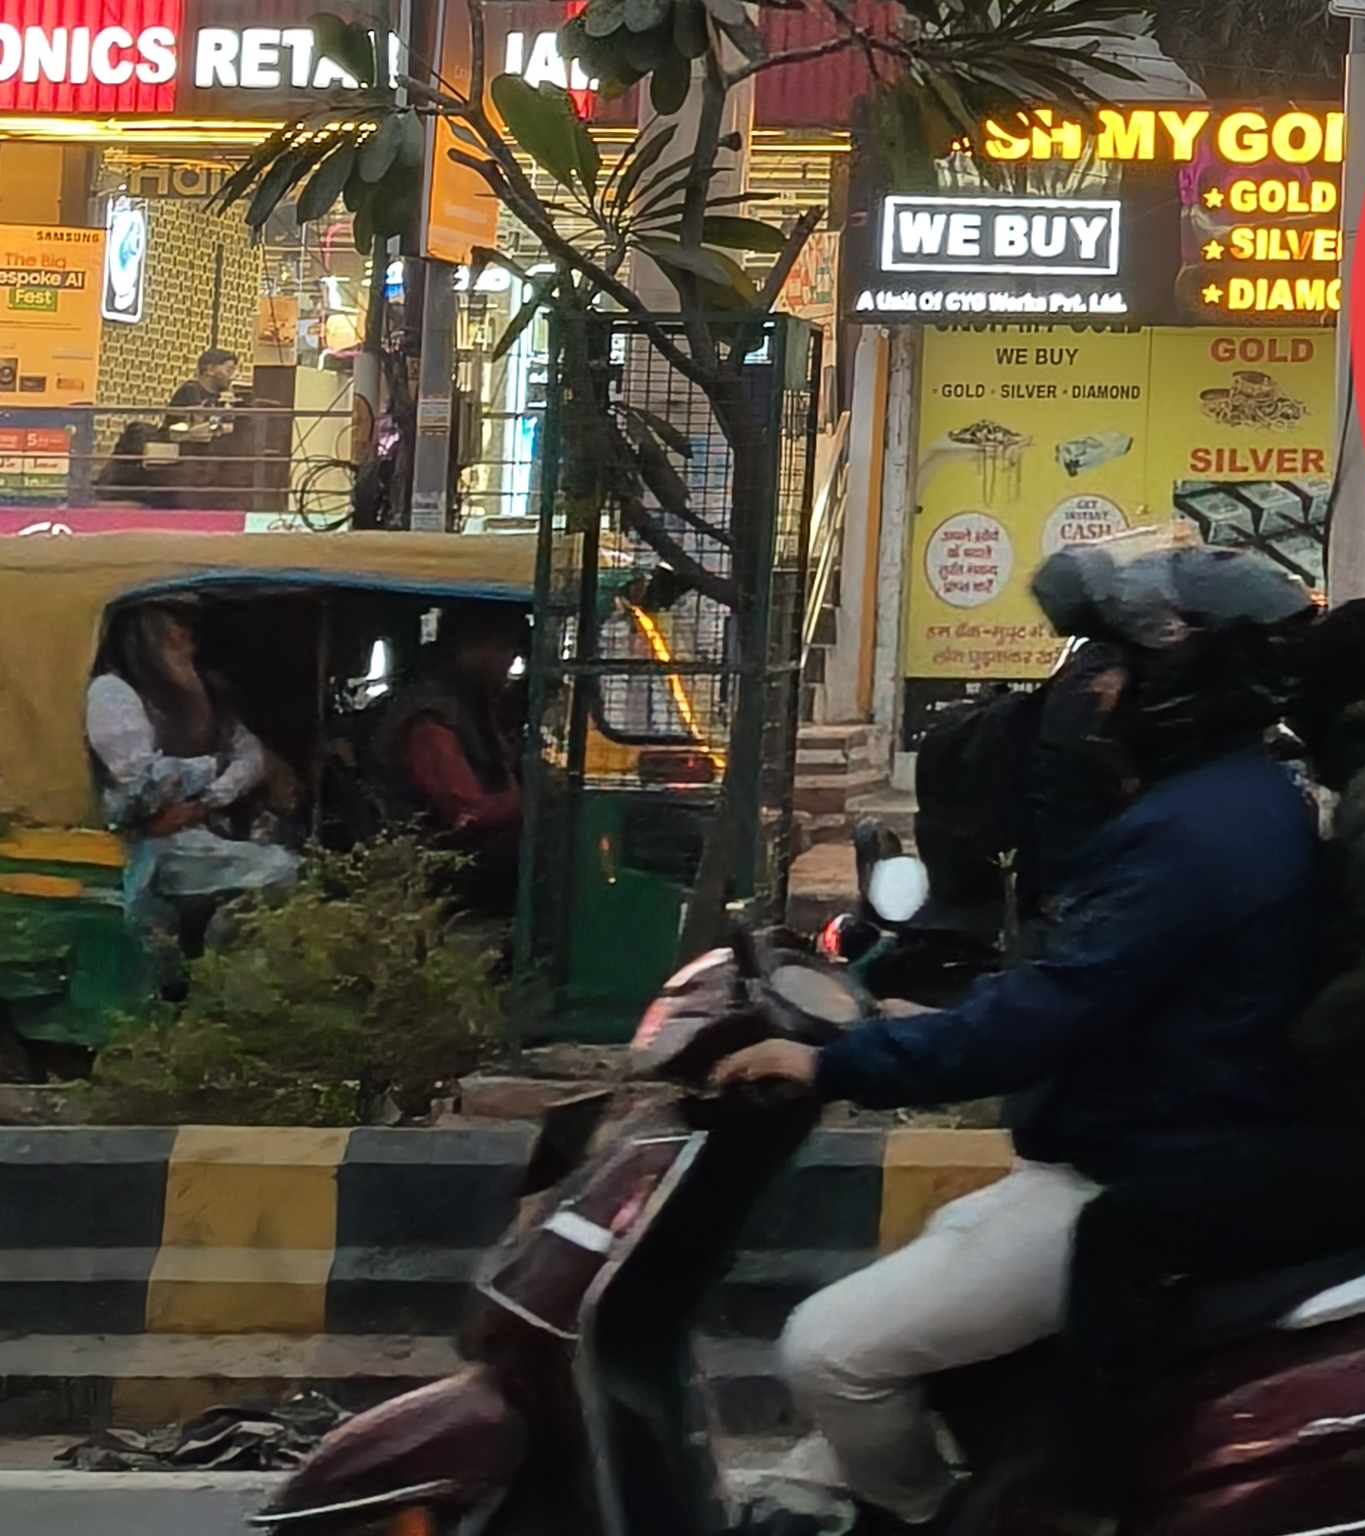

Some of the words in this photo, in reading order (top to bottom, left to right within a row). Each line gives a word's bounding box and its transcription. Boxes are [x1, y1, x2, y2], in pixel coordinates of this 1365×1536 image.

[1098, 109, 1210, 162] MY
[1229, 180, 1337, 215] GOLD
[36, 230, 101, 244] SAMSUNG
[898, 210, 983, 258] WE
[993, 215, 1108, 260] BUY
[1228, 228, 1344, 261] SILVE
[5, 251, 40, 269] The
[0, 271, 63, 289] espoke
[65, 272, 83, 289] AI
[15, 287, 54, 307] Fest
[855, 290, 875, 312] A
[876, 290, 917, 312] Unit
[919, 290, 944, 311] Of
[1048, 292, 1087, 313] Pvt.
[1088, 292, 1128, 314] Ltd.
[996, 347, 1028, 365] WE
[1034, 348, 1079, 366] BUY
[1211, 337, 1314, 364] GOLD
[941, 384, 986, 400] GOLD
[1000, 384, 1057, 400] SILVER
[1071, 384, 1141, 401] DIAMOND
[1190, 447, 1326, 474] SILVER
[1060, 521, 1113, 541] CASH
